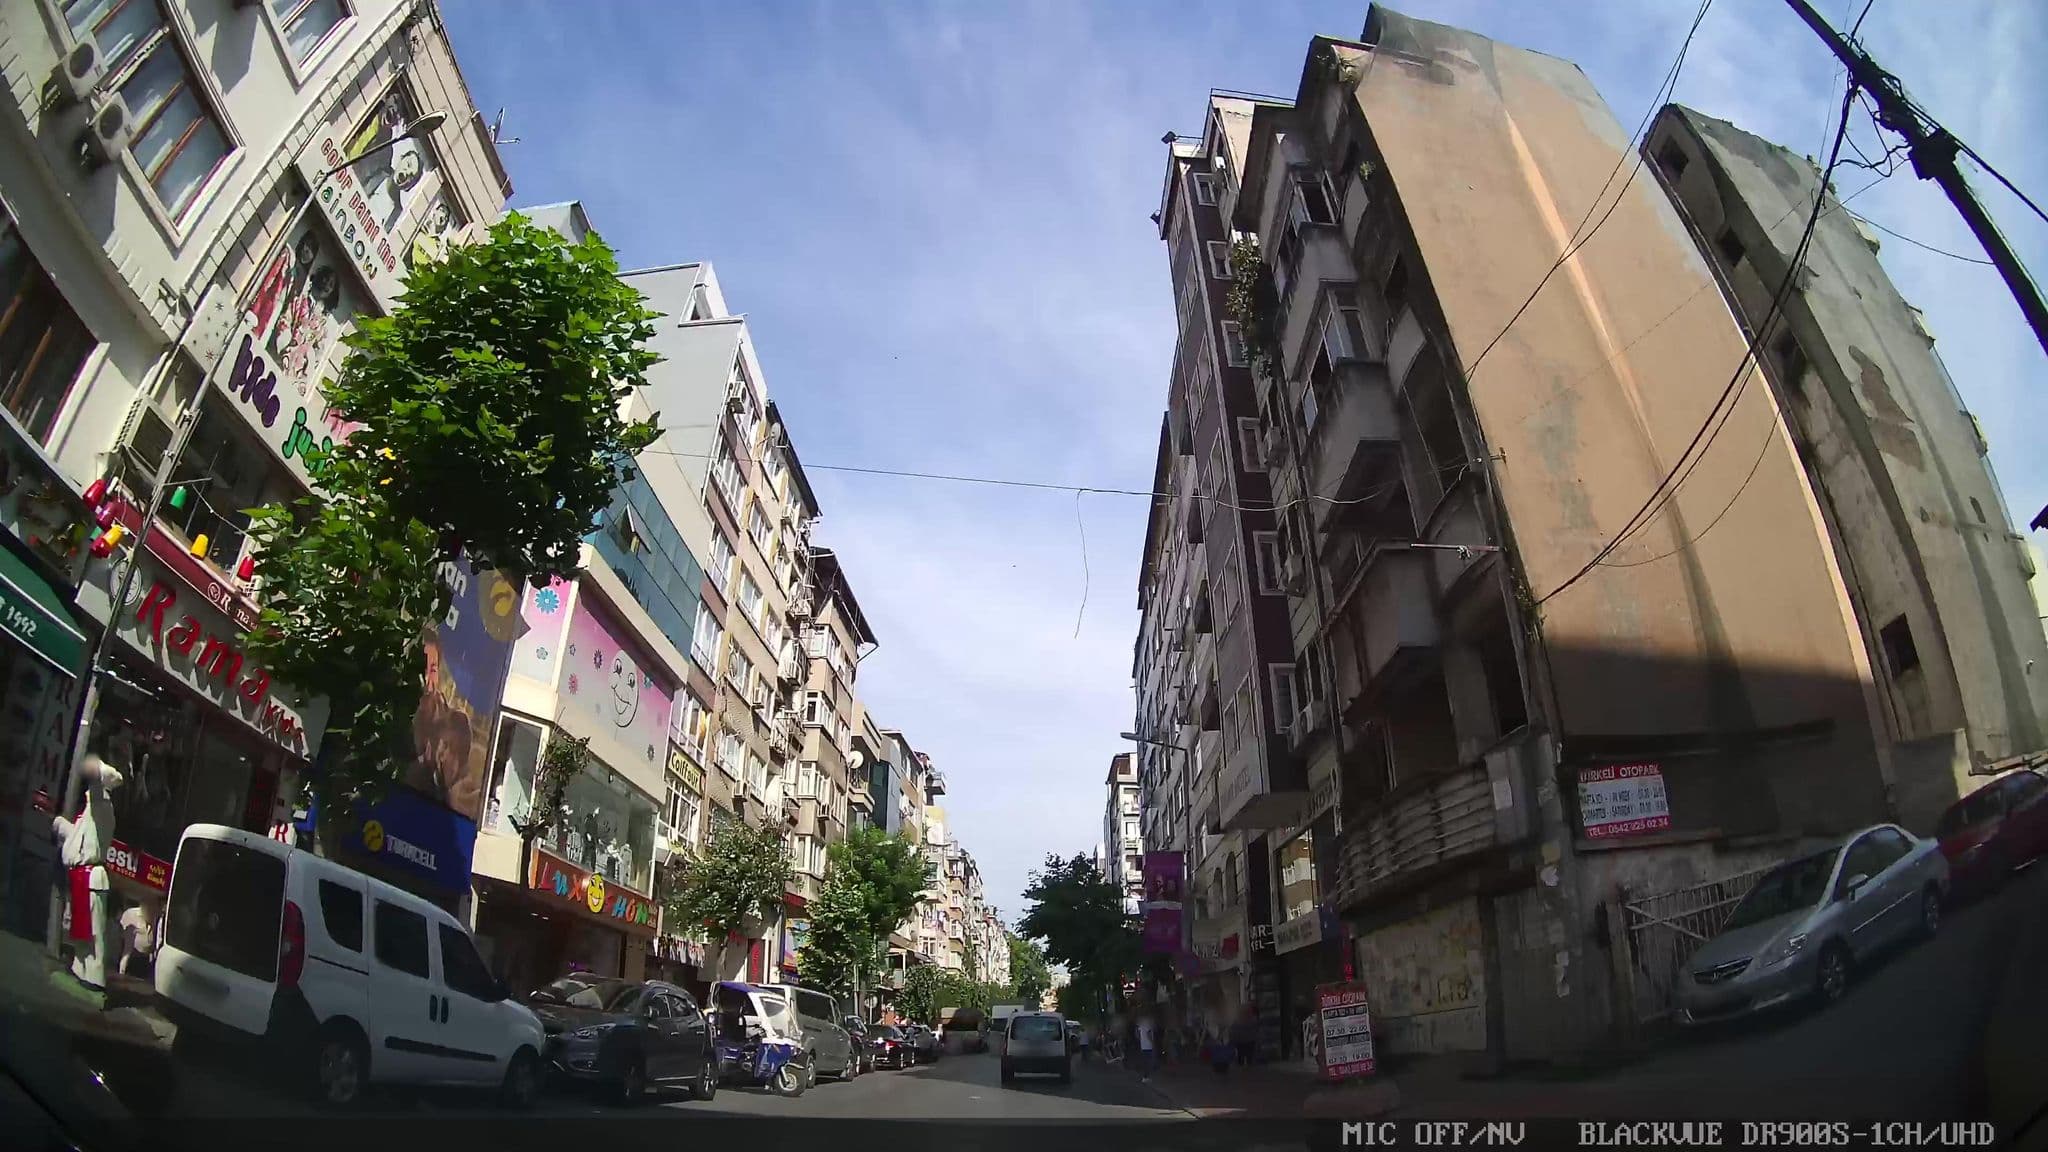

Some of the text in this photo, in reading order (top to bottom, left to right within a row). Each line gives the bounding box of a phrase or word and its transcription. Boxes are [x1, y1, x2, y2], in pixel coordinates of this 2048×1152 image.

[7, 606, 39, 638] 1992
[136, 581, 271, 705] Rama
[386, 834, 438, 871] TURKCELL
